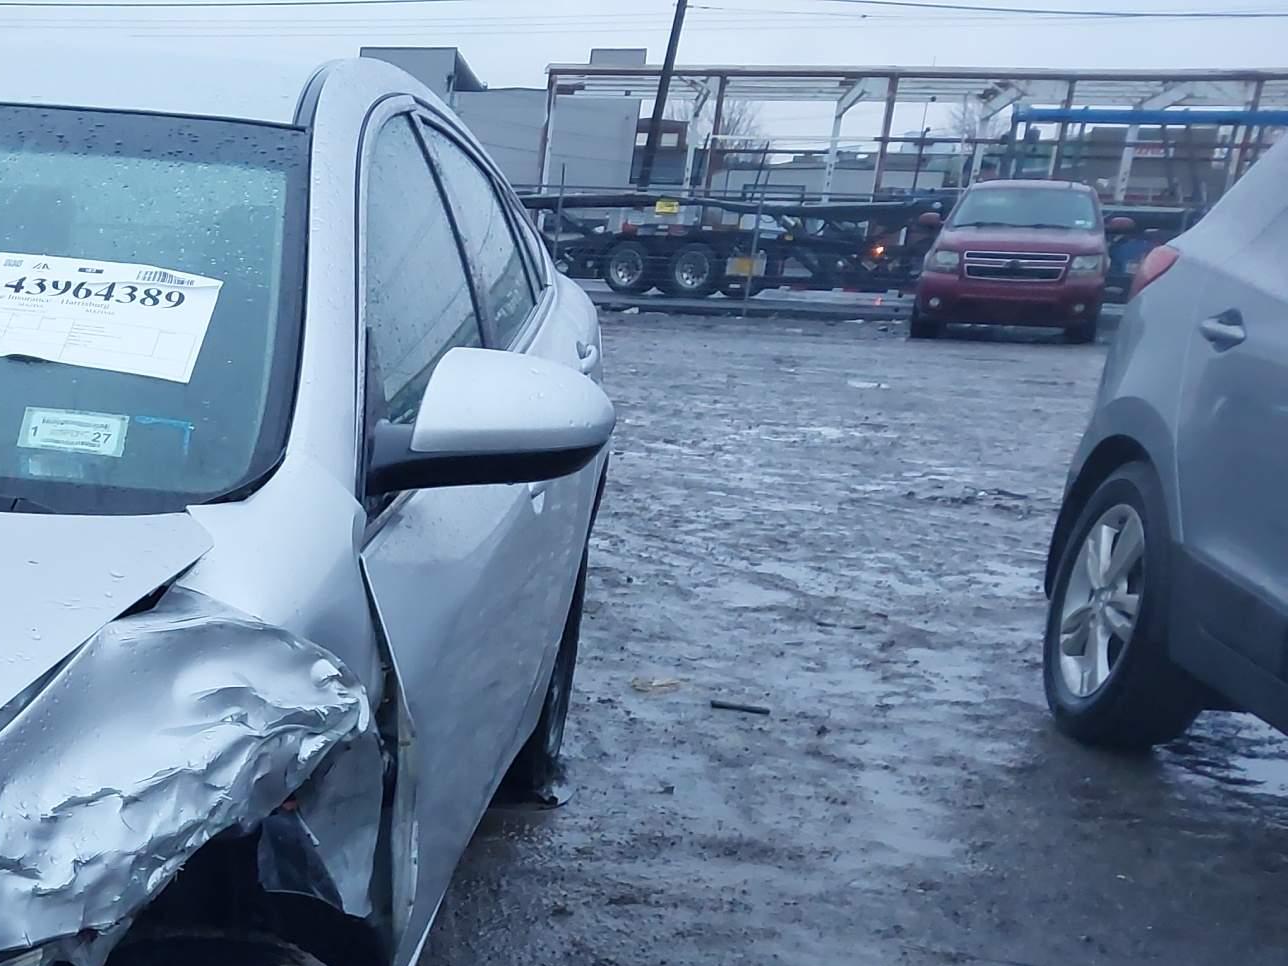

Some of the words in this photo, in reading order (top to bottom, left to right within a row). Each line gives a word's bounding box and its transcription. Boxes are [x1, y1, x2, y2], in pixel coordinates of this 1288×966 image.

[4, 276, 186, 309] 43964389
[31, 426, 38, 437] 1
[91, 431, 112, 444] 27
